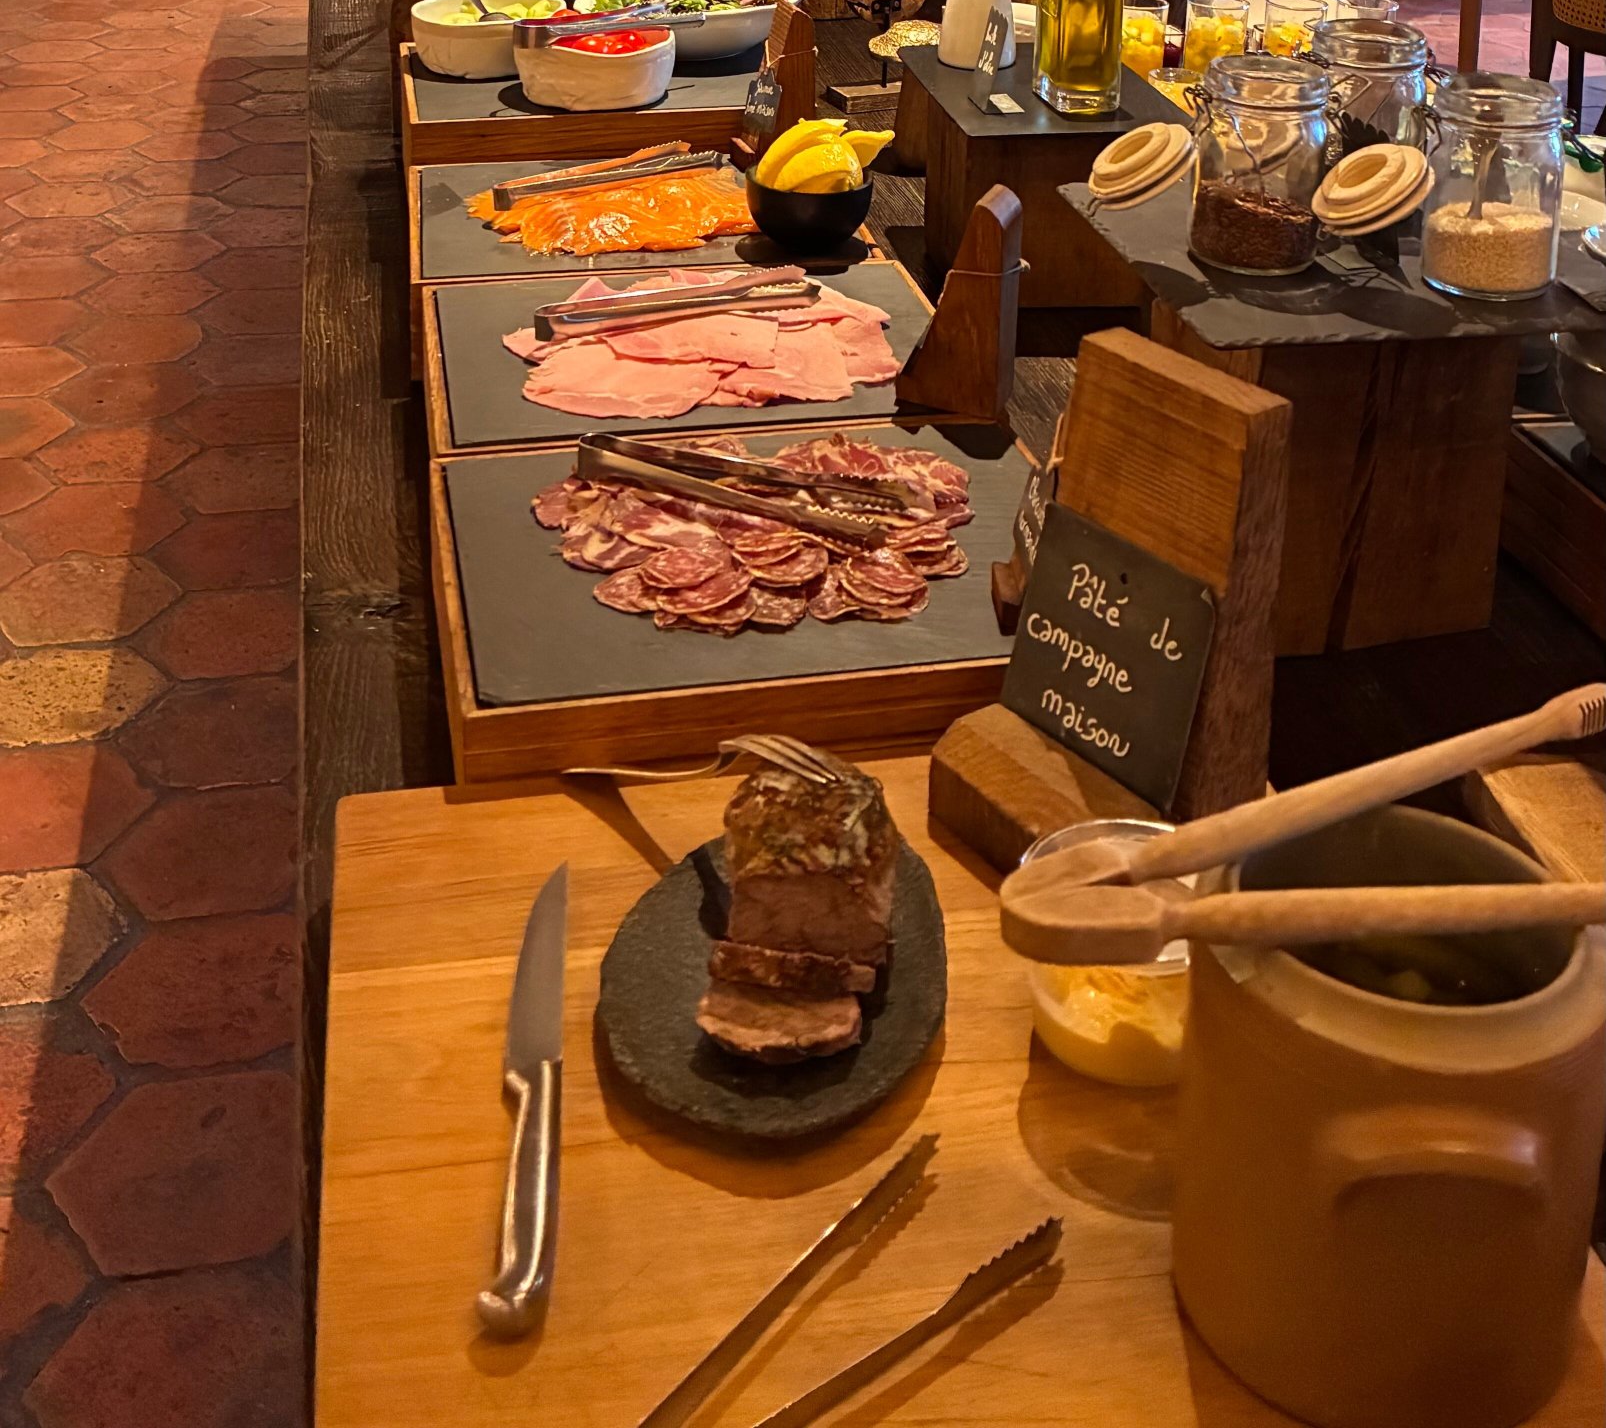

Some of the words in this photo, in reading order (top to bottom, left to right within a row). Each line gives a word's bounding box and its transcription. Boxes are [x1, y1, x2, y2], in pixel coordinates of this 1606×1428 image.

[1067, 563, 1129, 627] Pâté
[1150, 617, 1182, 660] de
[1027, 613, 1132, 693] campagne
[1041, 689, 1130, 758] maison
